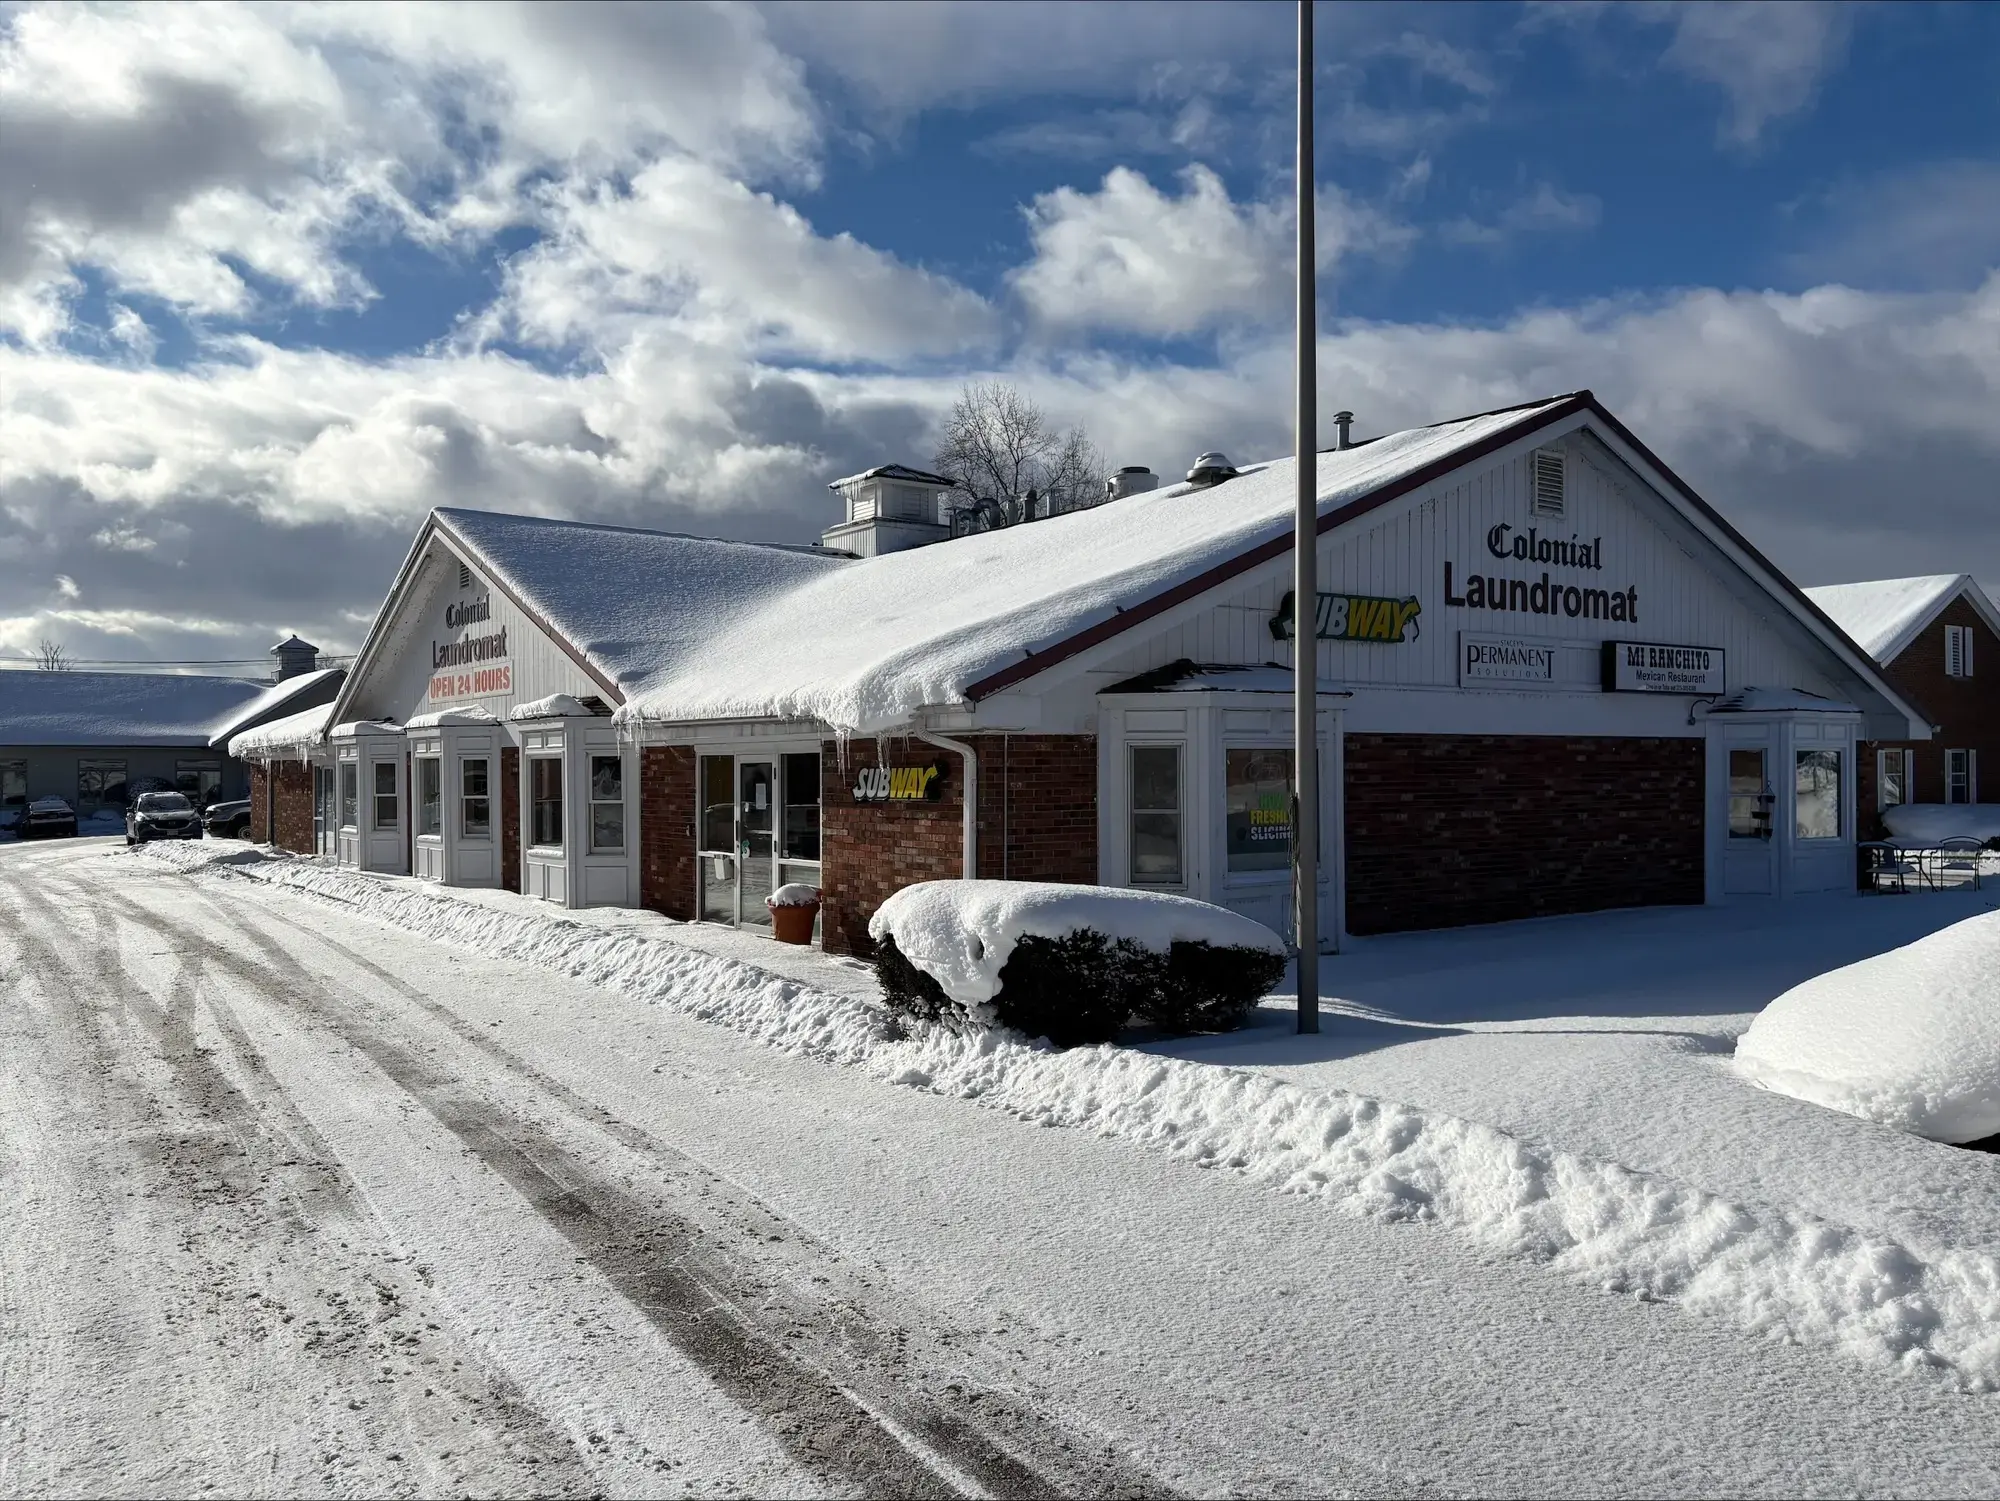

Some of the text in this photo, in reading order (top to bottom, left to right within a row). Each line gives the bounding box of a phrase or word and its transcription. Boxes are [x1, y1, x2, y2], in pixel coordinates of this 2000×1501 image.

[1487, 523, 1602, 570] Colonial
[1444, 561, 1638, 623] Laundromat
[445, 593, 491, 629] Colonial
[432, 625, 508, 669] Laundromat
[1467, 644, 1555, 678] PERMANENT
[1627, 646, 1710, 670] MI RANCHITO
[430, 665, 511, 699] OPEN 24 HOURS
[1477, 668, 1547, 678] SOLUTIONS
[1636, 669, 1706, 684] Mexican Restaurant
[852, 767, 938, 798] SUBWAY
[1250, 809, 1290, 824] FRESHL
